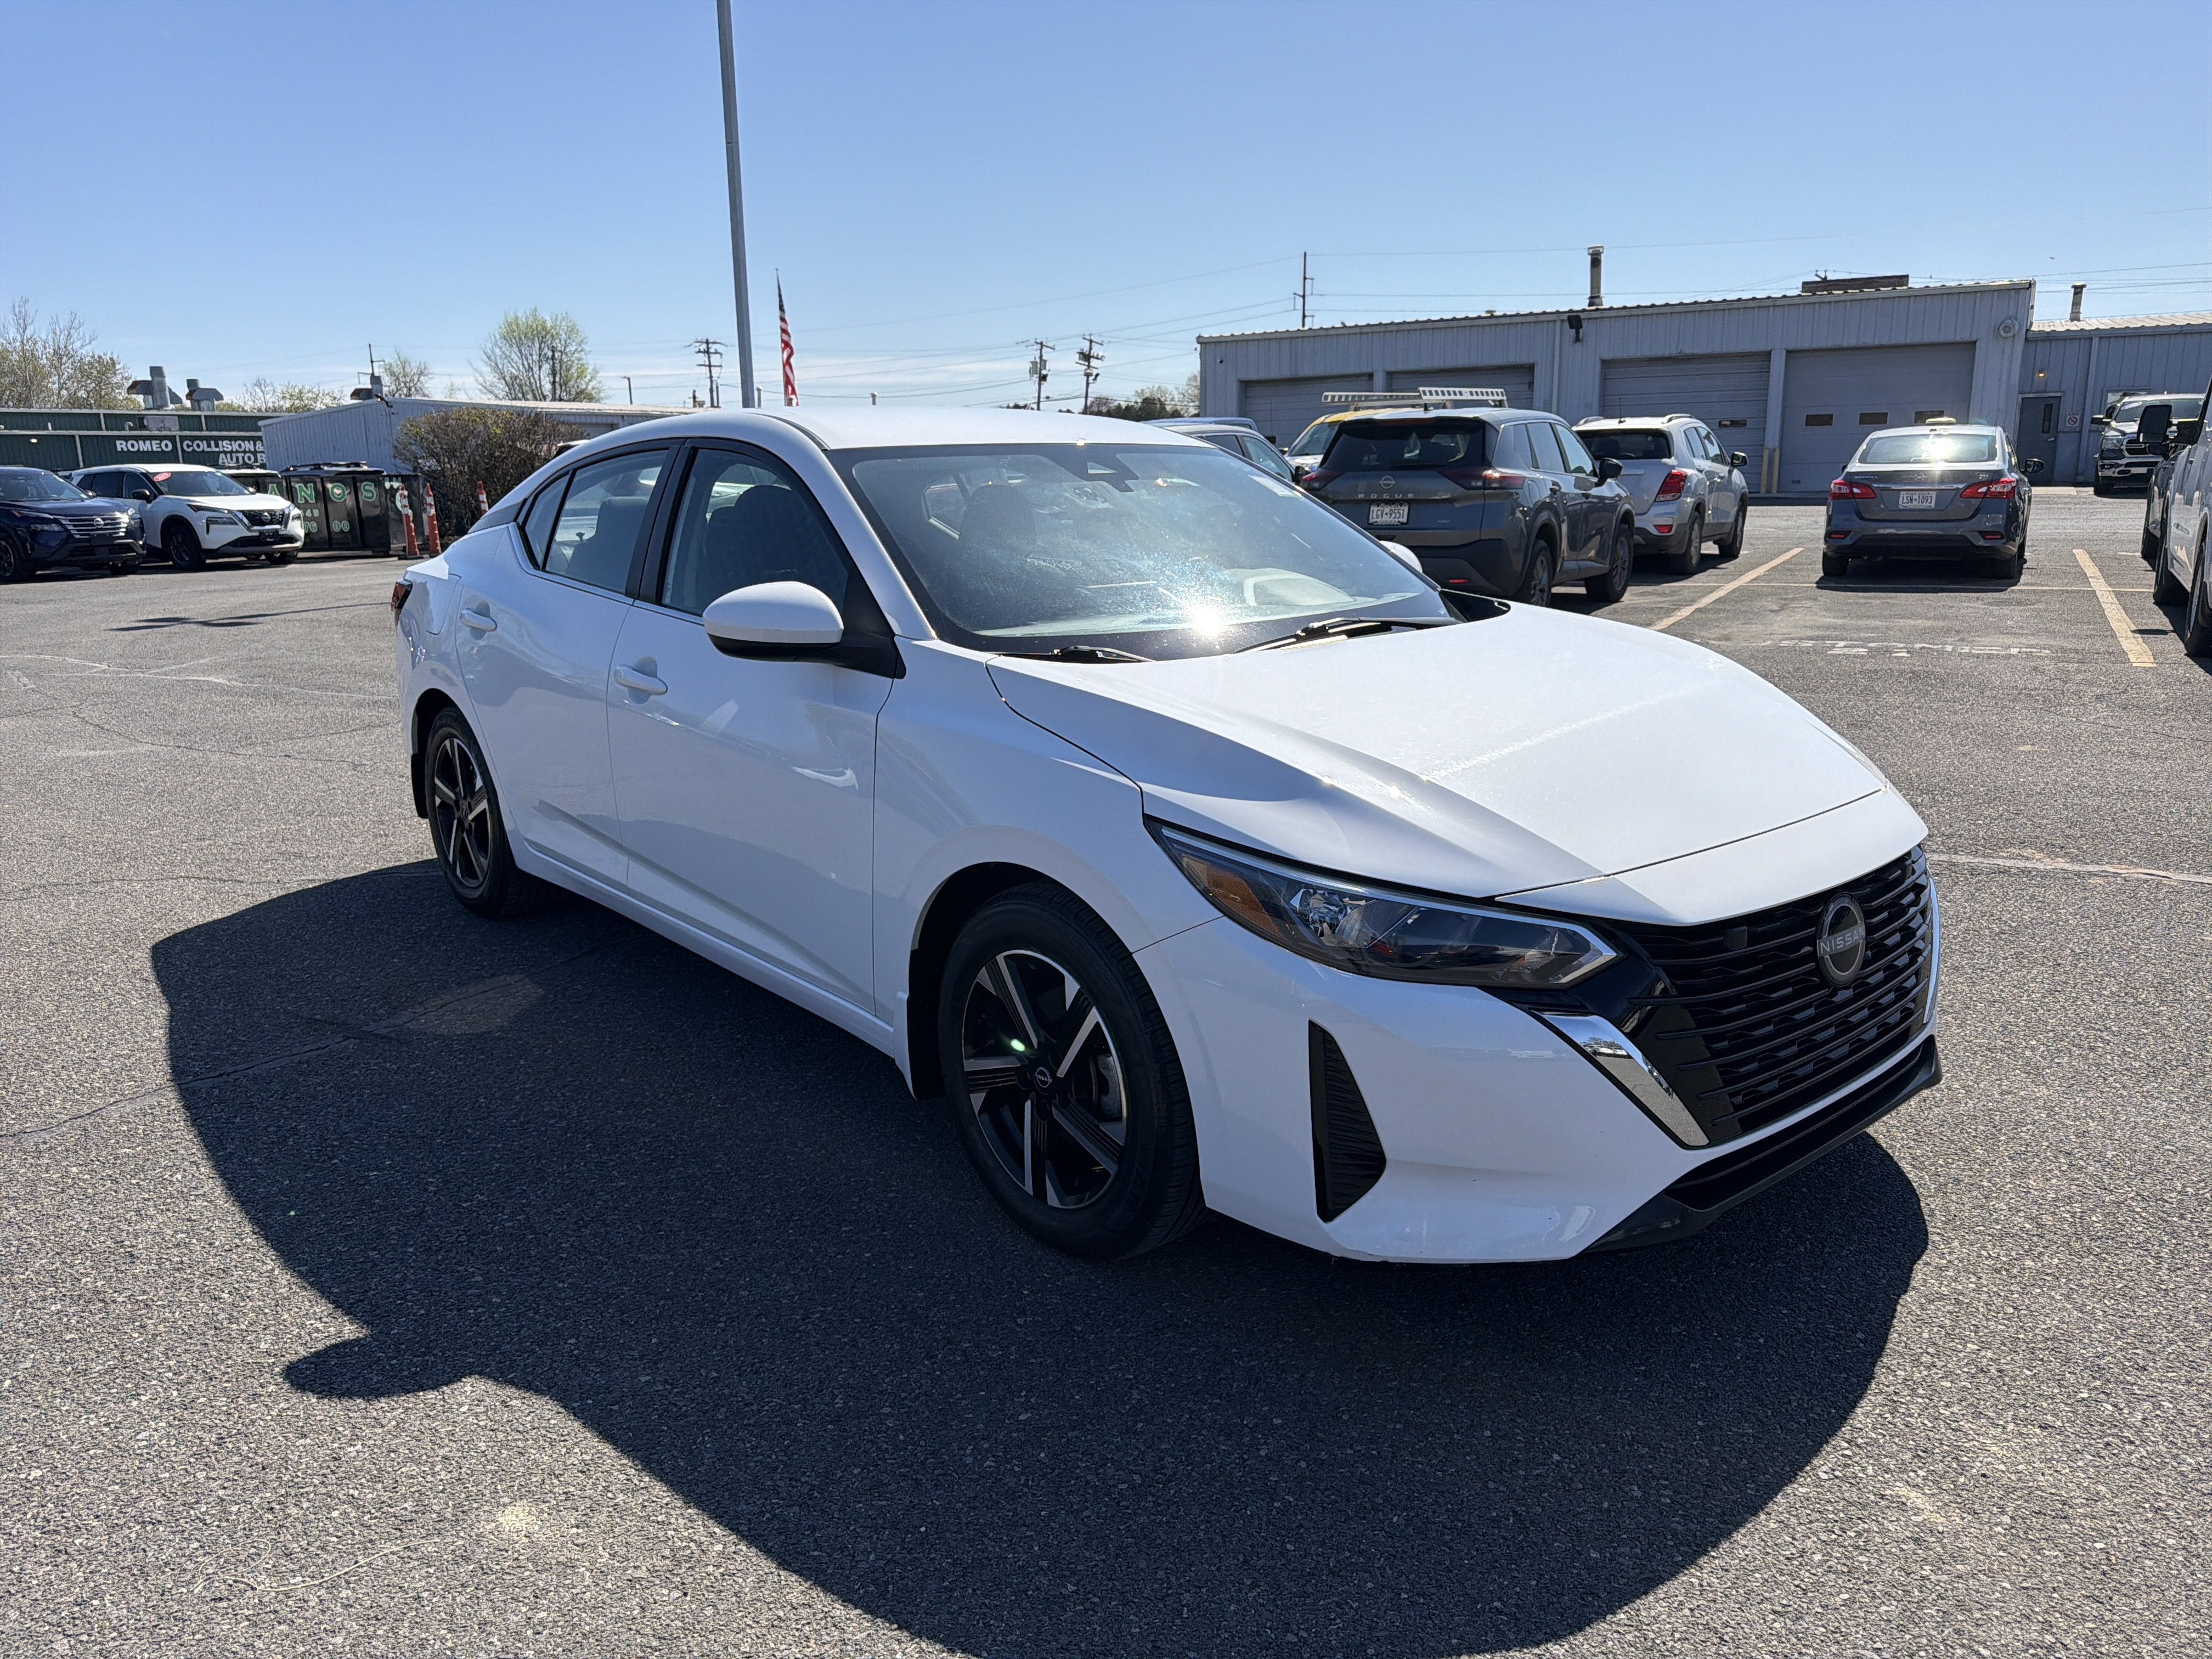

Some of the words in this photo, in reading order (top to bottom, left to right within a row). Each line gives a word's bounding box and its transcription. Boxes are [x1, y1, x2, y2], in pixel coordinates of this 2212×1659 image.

[116, 440, 172, 452] ROMEO
[183, 440, 254, 452] COLLISION
[255, 441, 264, 452] &
[218, 453, 255, 465] AUTO
[1820, 927, 1864, 954] NISSAN
